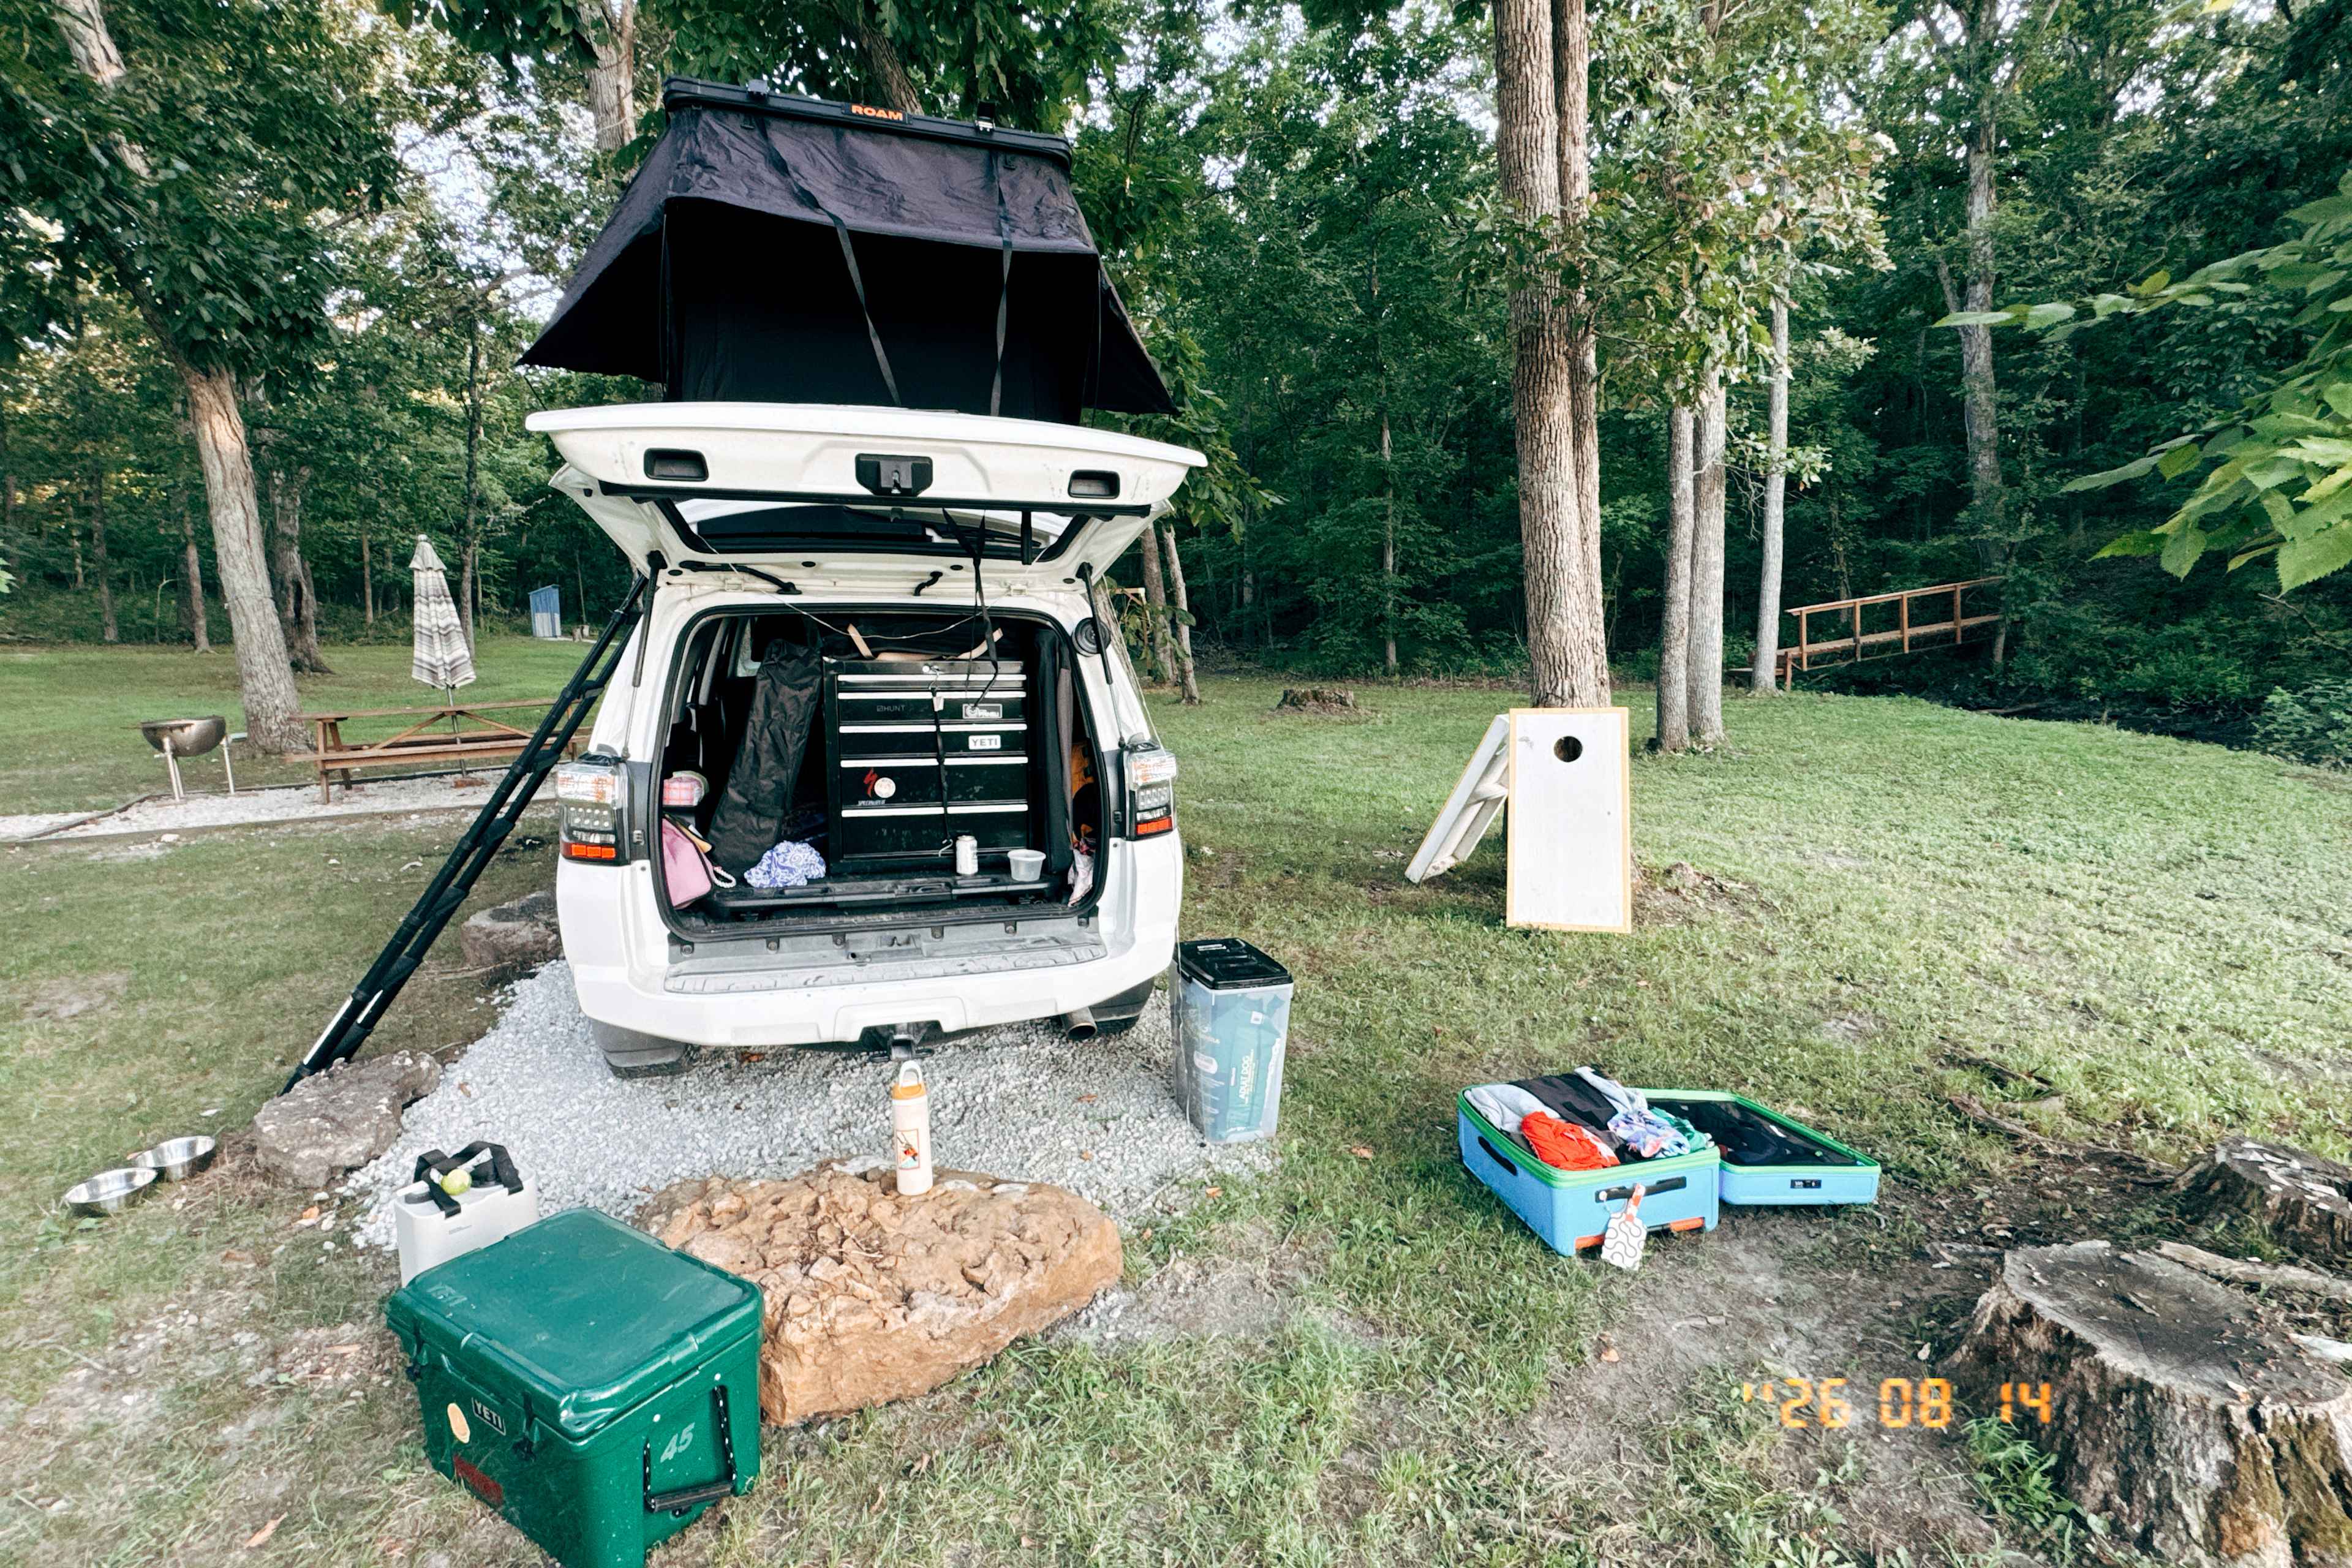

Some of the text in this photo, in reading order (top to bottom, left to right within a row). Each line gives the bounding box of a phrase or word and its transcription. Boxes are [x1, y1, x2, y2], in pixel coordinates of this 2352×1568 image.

[851, 104, 903, 121] ROAM
[971, 738, 998, 747] YETI
[1238, 1055, 1250, 1099] ADULT DOG
[474, 1398, 502, 1430] YETI
[660, 1422, 695, 1463] 45
